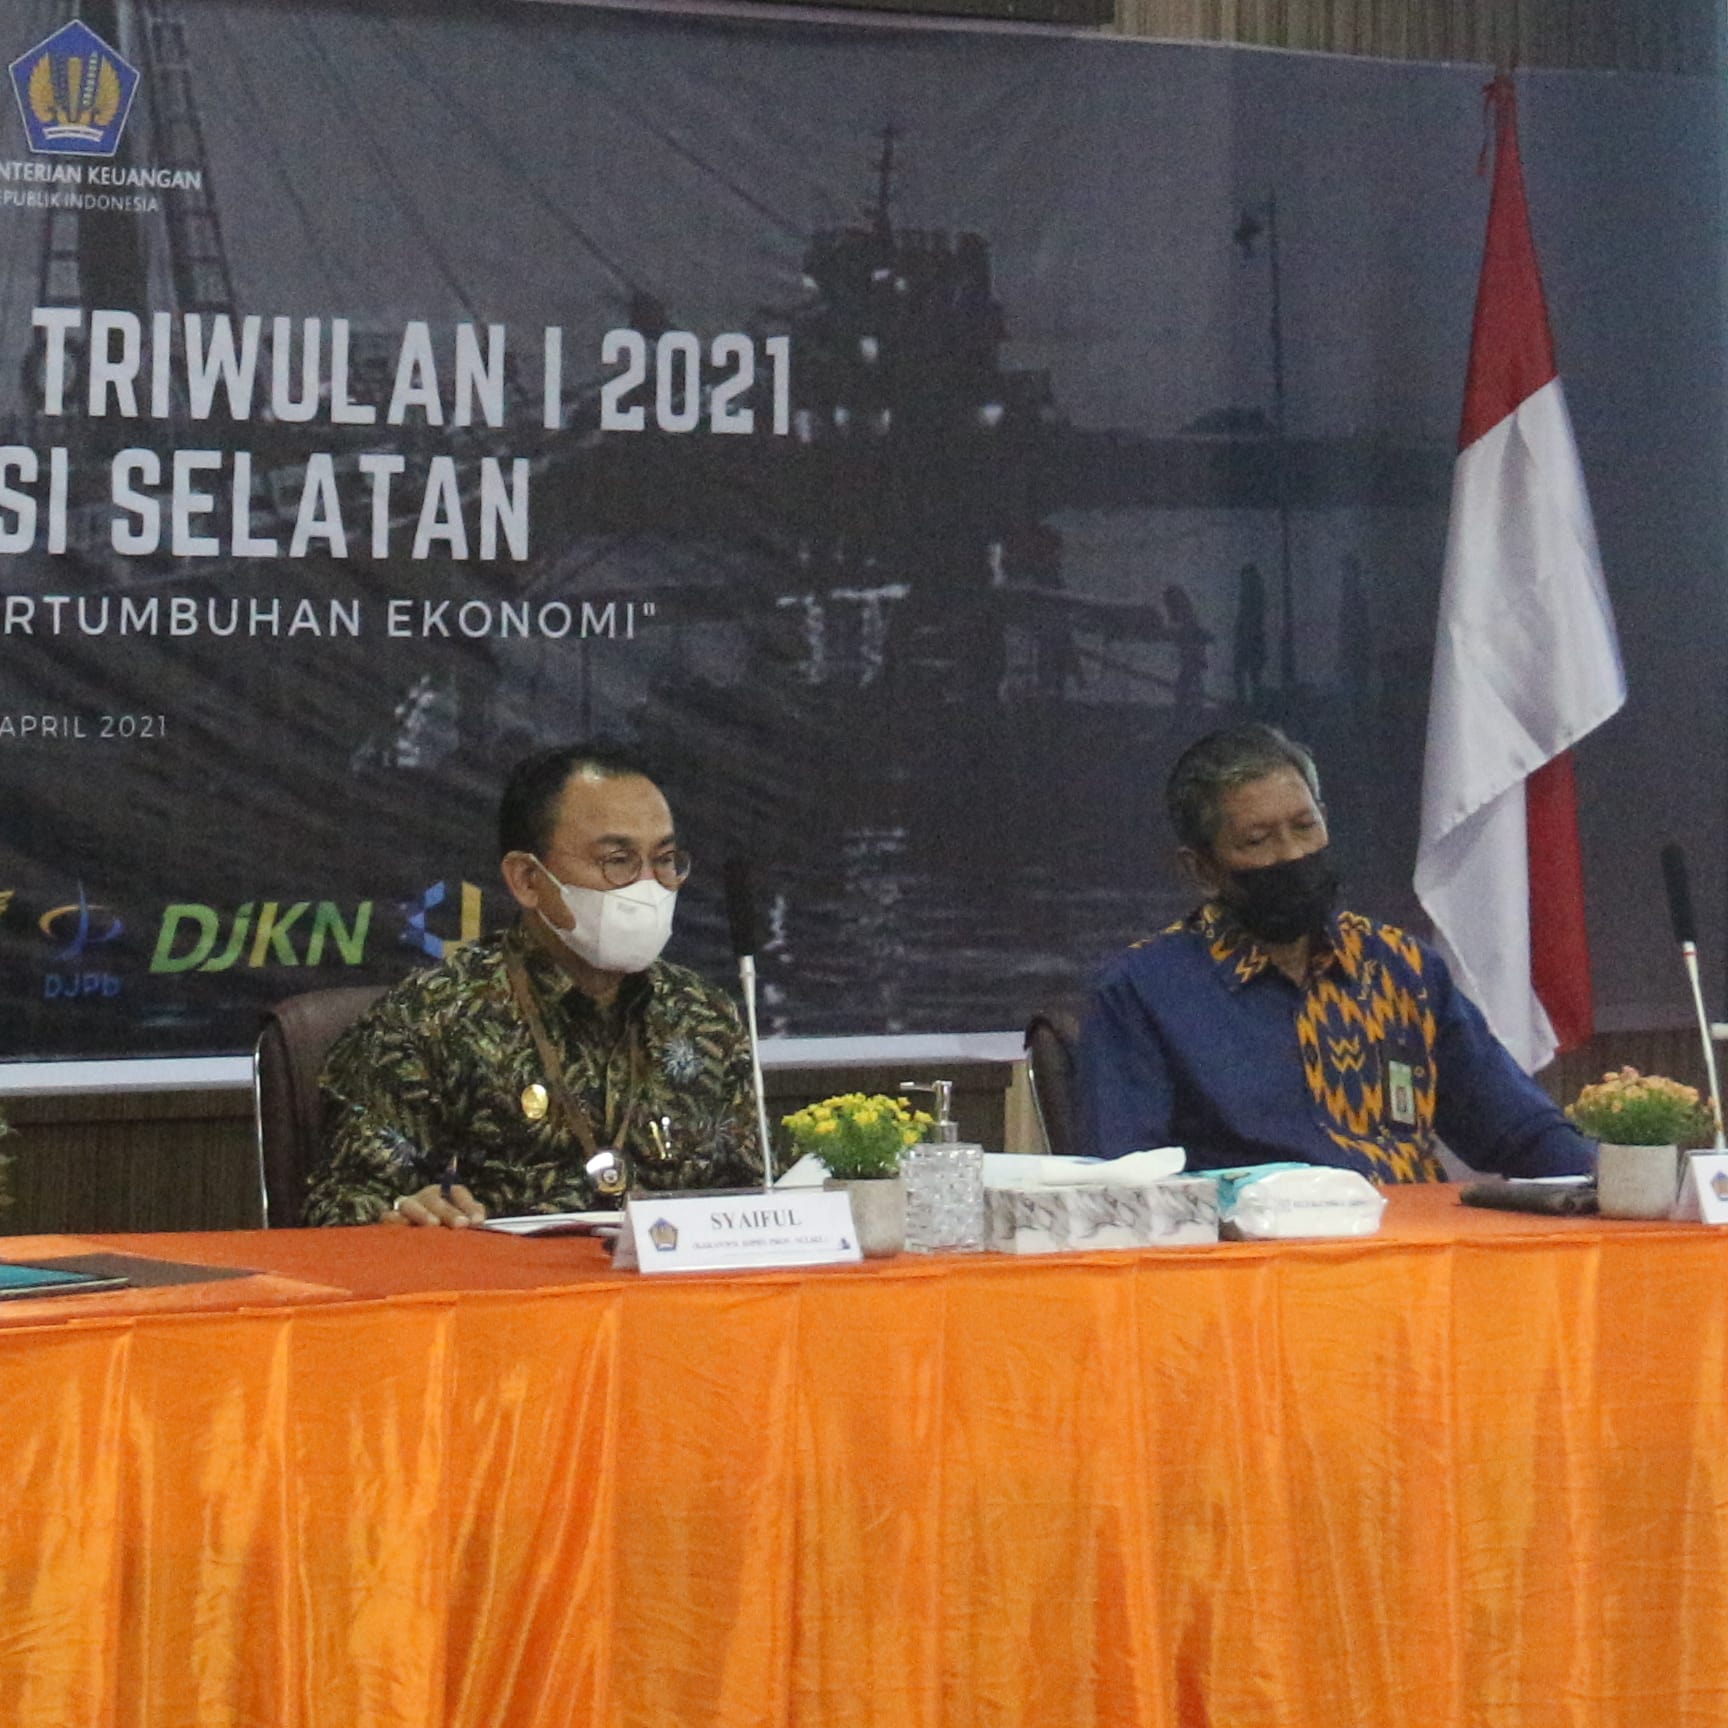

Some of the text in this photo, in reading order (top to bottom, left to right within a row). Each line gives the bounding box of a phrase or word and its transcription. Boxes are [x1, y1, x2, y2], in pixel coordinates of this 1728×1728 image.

[87, 165, 203, 190] KEUANGAN
[64, 193, 159, 213] INDONESIA
[32, 306, 506, 429] TRIWULAN
[543, 325, 563, 430] I
[599, 328, 791, 436] 2021
[110, 447, 529, 561] SELATAN
[386, 599, 658, 640] EKONOMI"
[99, 715, 166, 739] 2021
[710, 1208, 803, 1231] SYAIFUL
